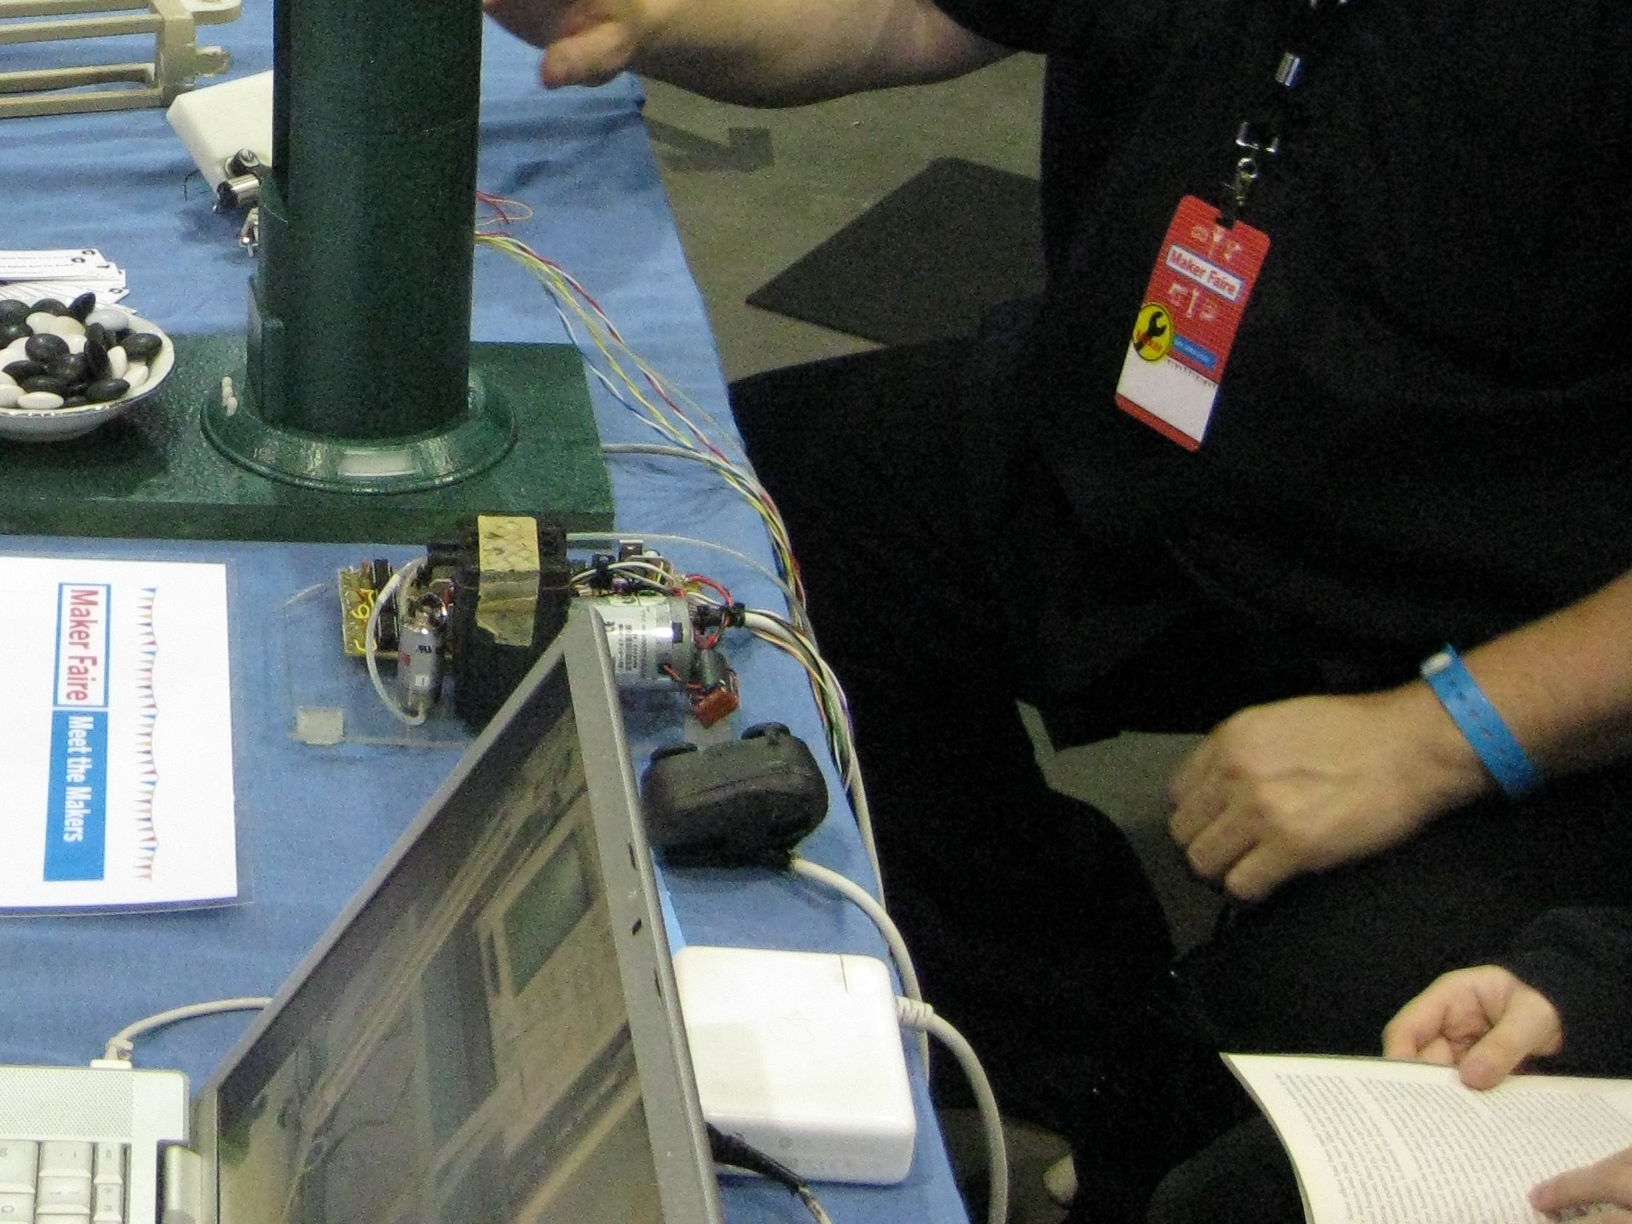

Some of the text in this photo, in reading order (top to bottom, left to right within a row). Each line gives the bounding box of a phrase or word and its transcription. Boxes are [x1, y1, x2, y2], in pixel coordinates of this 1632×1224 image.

[1169, 250, 1237, 294] Maker Faire
[65, 589, 98, 700] Maker Faire
[62, 715, 93, 842] Meet the Makers
